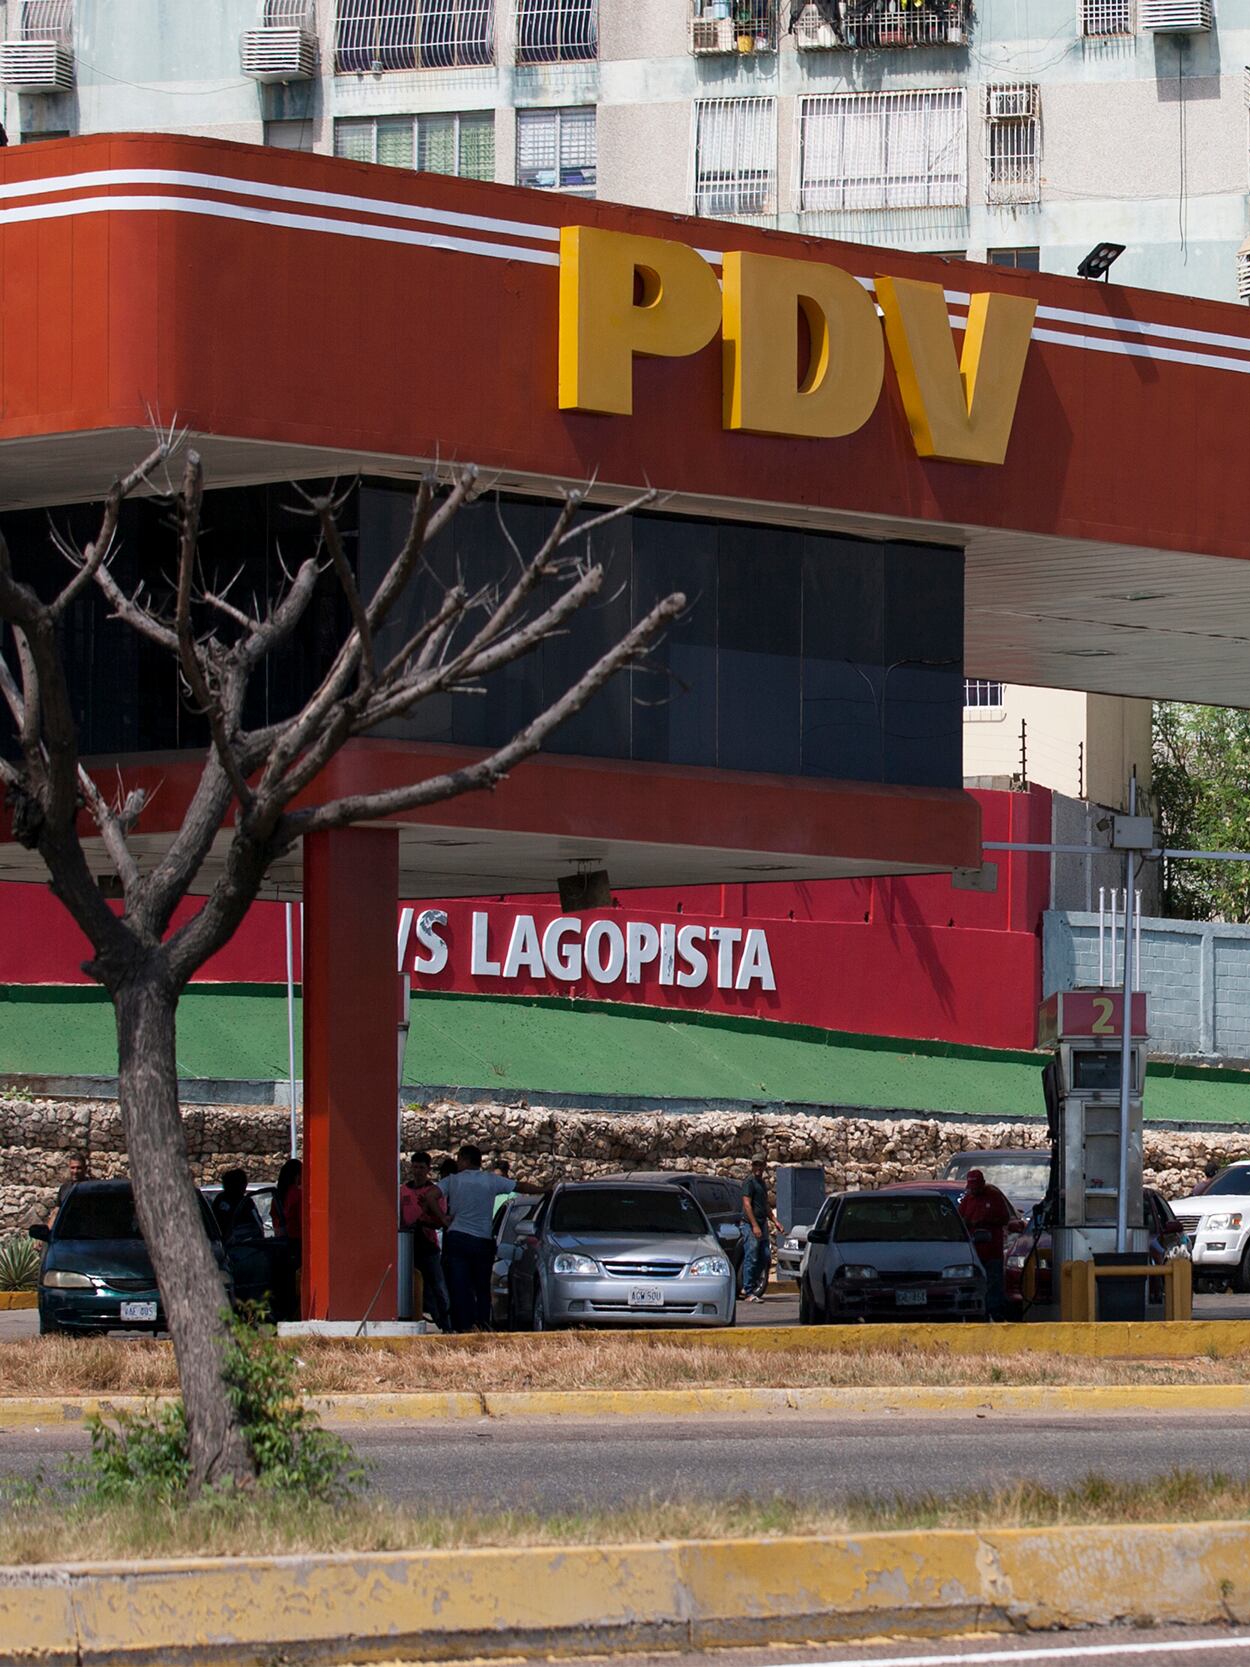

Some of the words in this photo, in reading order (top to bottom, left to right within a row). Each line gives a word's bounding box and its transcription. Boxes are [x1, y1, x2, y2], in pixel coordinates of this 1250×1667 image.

[559, 225, 1038, 465] PDV
[470, 911, 777, 991] LAGOPISTA
[1092, 997, 1115, 1034] 2
